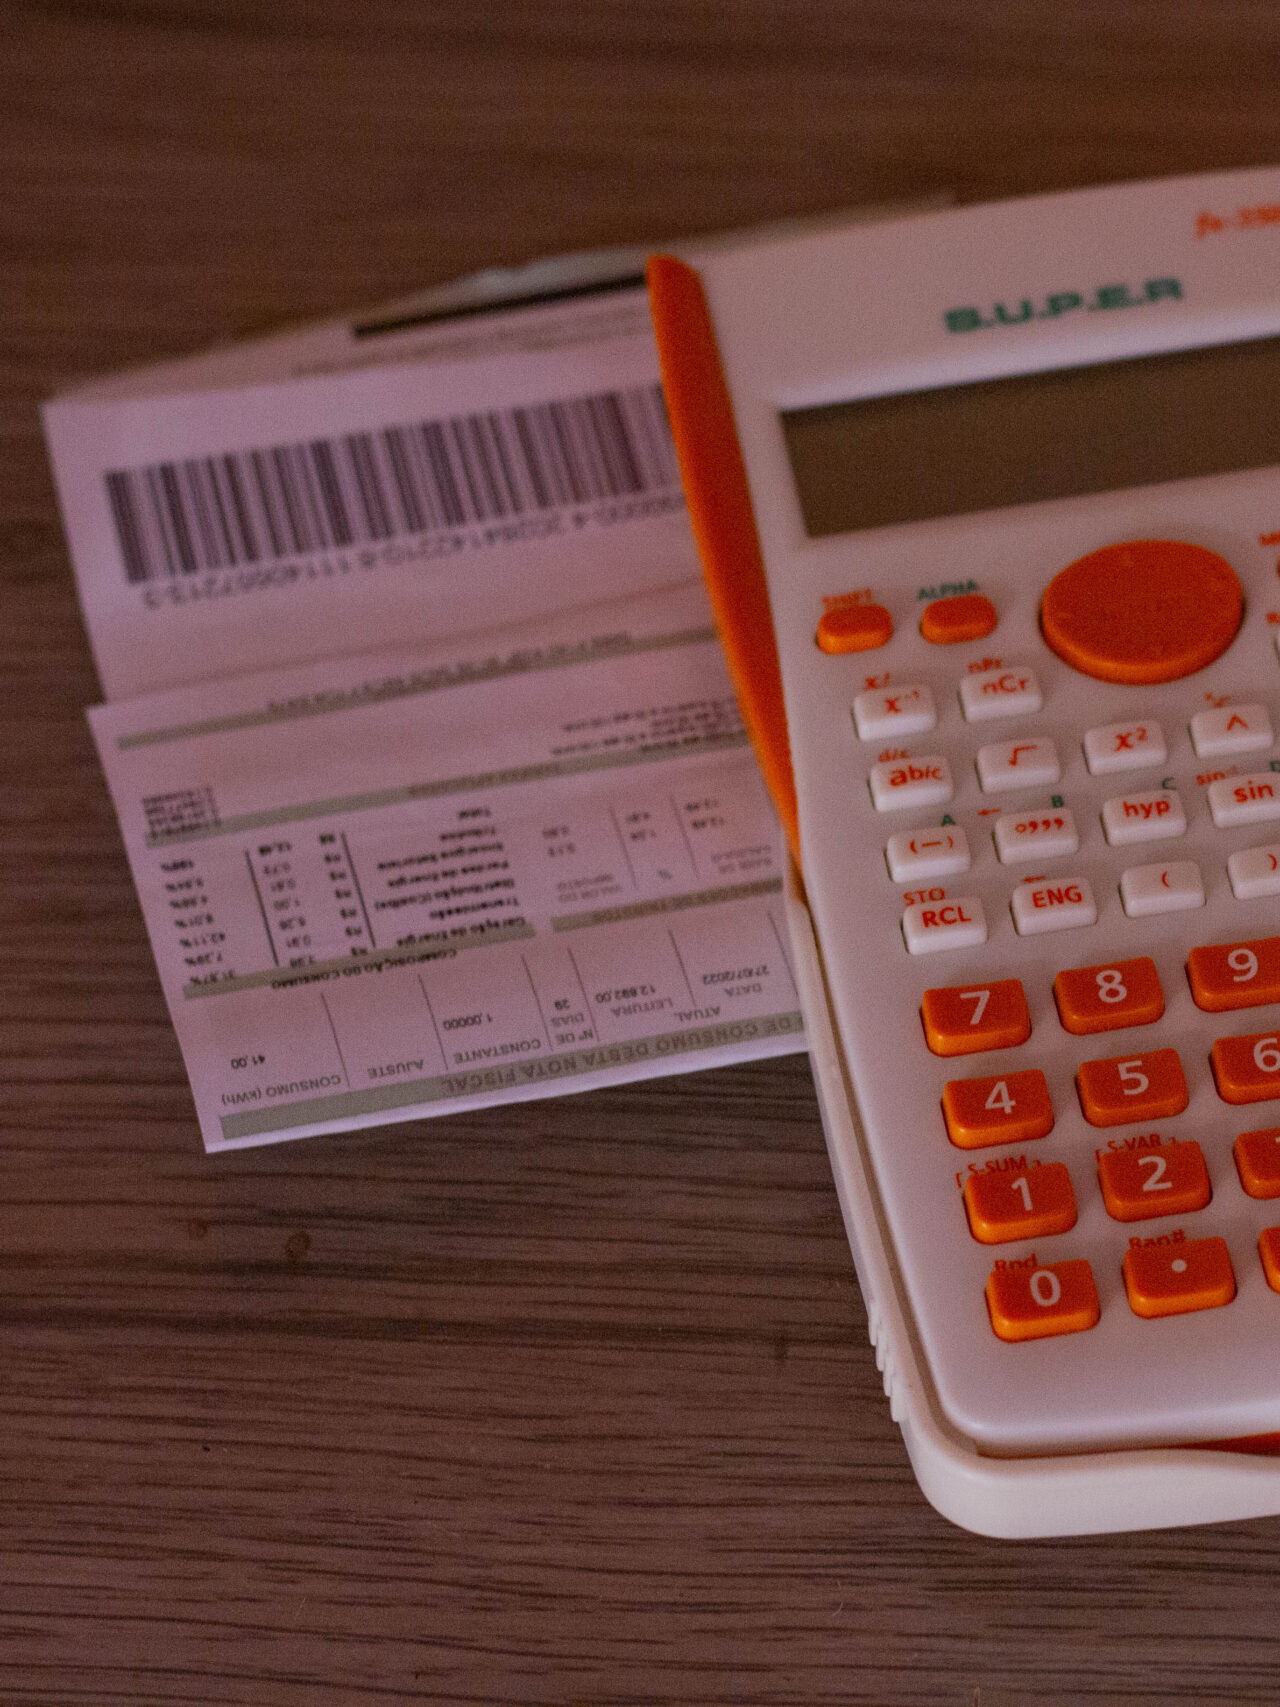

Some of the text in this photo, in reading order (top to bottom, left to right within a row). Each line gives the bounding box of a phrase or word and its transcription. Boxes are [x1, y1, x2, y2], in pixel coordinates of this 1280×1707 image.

[1233, 779, 1275, 803] sin
[1122, 799, 1171, 821] hyp
[903, 888, 946, 907] STO
[1032, 885, 1083, 908] ENG
[922, 905, 972, 928] RCL
[1227, 948, 1259, 982] 9
[723, 981, 762, 997] DATA
[1095, 969, 1127, 1003] 8
[550, 1011, 583, 1027] DIAS
[610, 997, 672, 1017] LEITURA
[674, 1005, 720, 1023] ATUAL
[960, 990, 990, 1025] 7
[555, 1032, 575, 1045] DE
[655, 1021, 758, 1053] CONSUMO
[452, 1038, 541, 1064] CONSTANTE
[366, 1058, 425, 1079] AJUSTE
[519, 1055, 575, 1079] NOTA
[1117, 1060, 1149, 1096] 5
[265, 1073, 341, 1097] CONSUMO
[441, 1067, 516, 1093] FISCAL
[984, 1081, 1016, 1114] 4
[1137, 1155, 1173, 1192] 2
[1010, 1177, 1034, 1211] 1
[1029, 1270, 1061, 1306] 0
